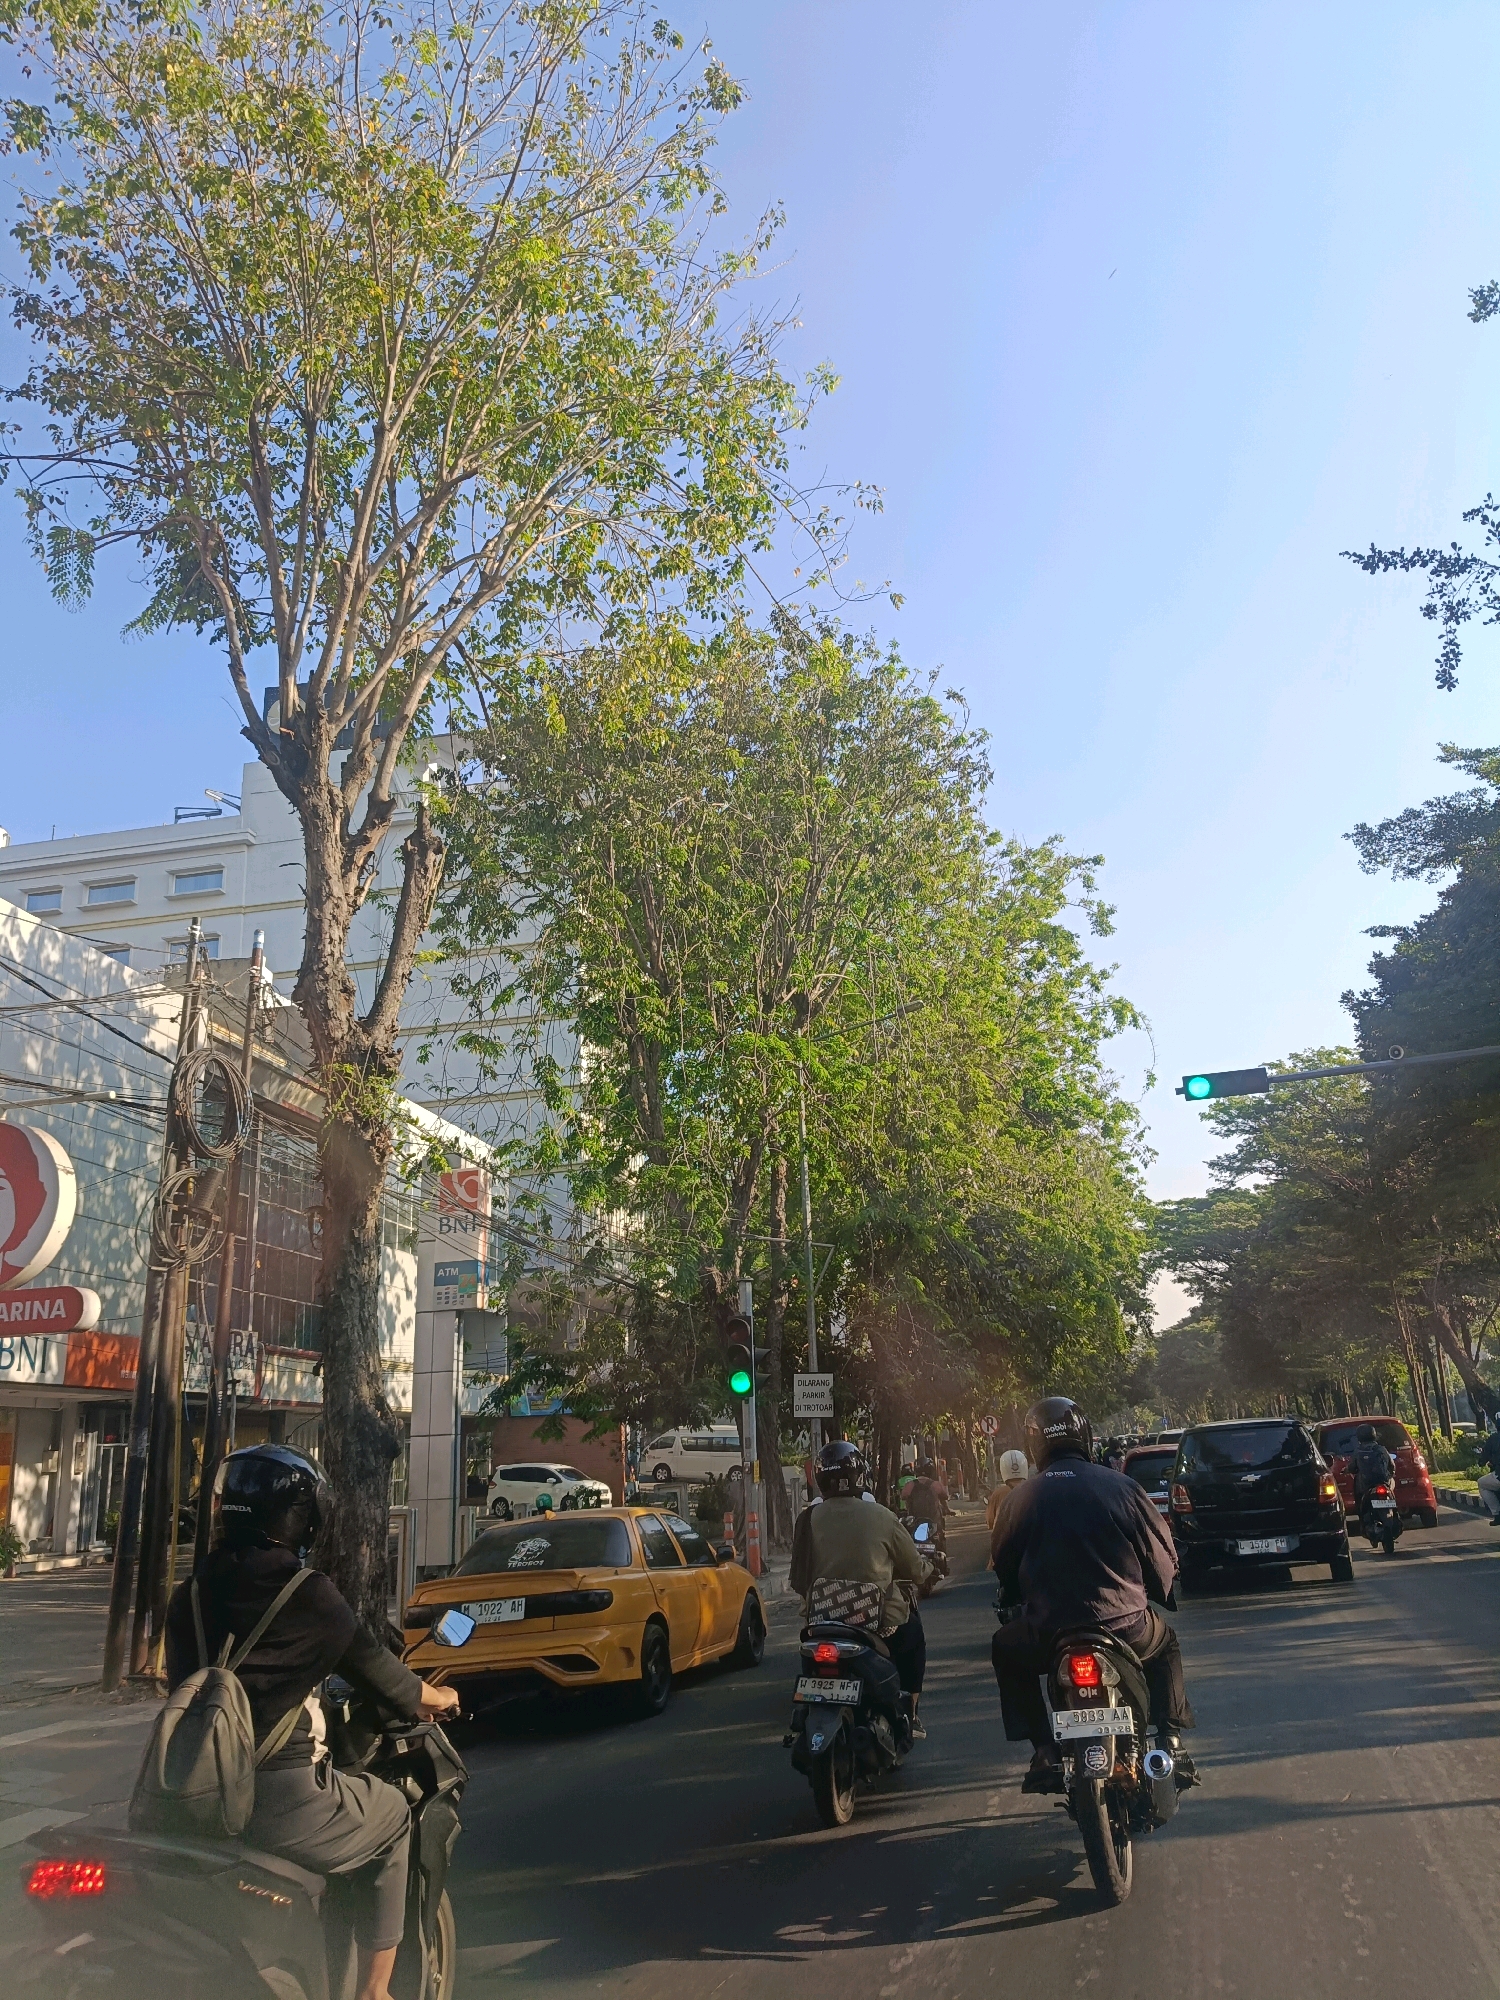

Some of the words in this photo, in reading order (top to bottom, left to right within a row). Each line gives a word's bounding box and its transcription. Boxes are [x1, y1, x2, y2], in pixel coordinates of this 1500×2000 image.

[439, 1213, 476, 1234] BNI
[437, 1267, 459, 1277] ATM
[0, 1336, 50, 1374] BNI
[797, 1379, 831, 1387] DILARANG
[802, 1391, 826, 1399] PARKIR
[795, 1404, 802, 1412] DI
[803, 1403, 833, 1412] TROTOAR
[221, 1504, 252, 1513] HONDA
[823, 1582, 841, 1596] MARVEL
[836, 1589, 857, 1603] MARVEL
[477, 1603, 502, 1616] 1922
[510, 1600, 523, 1613] AH
[814, 1598, 834, 1612] MARVEL
[852, 1596, 873, 1610] MARVEL
[828, 1605, 849, 1619] MARVEL
[844, 1612, 865, 1625] MARVEL
[800, 1680, 808, 1689] W
[811, 1680, 835, 1690] 3925
[1056, 1713, 1064, 1725] L
[1113, 1708, 1129, 1721] AA
